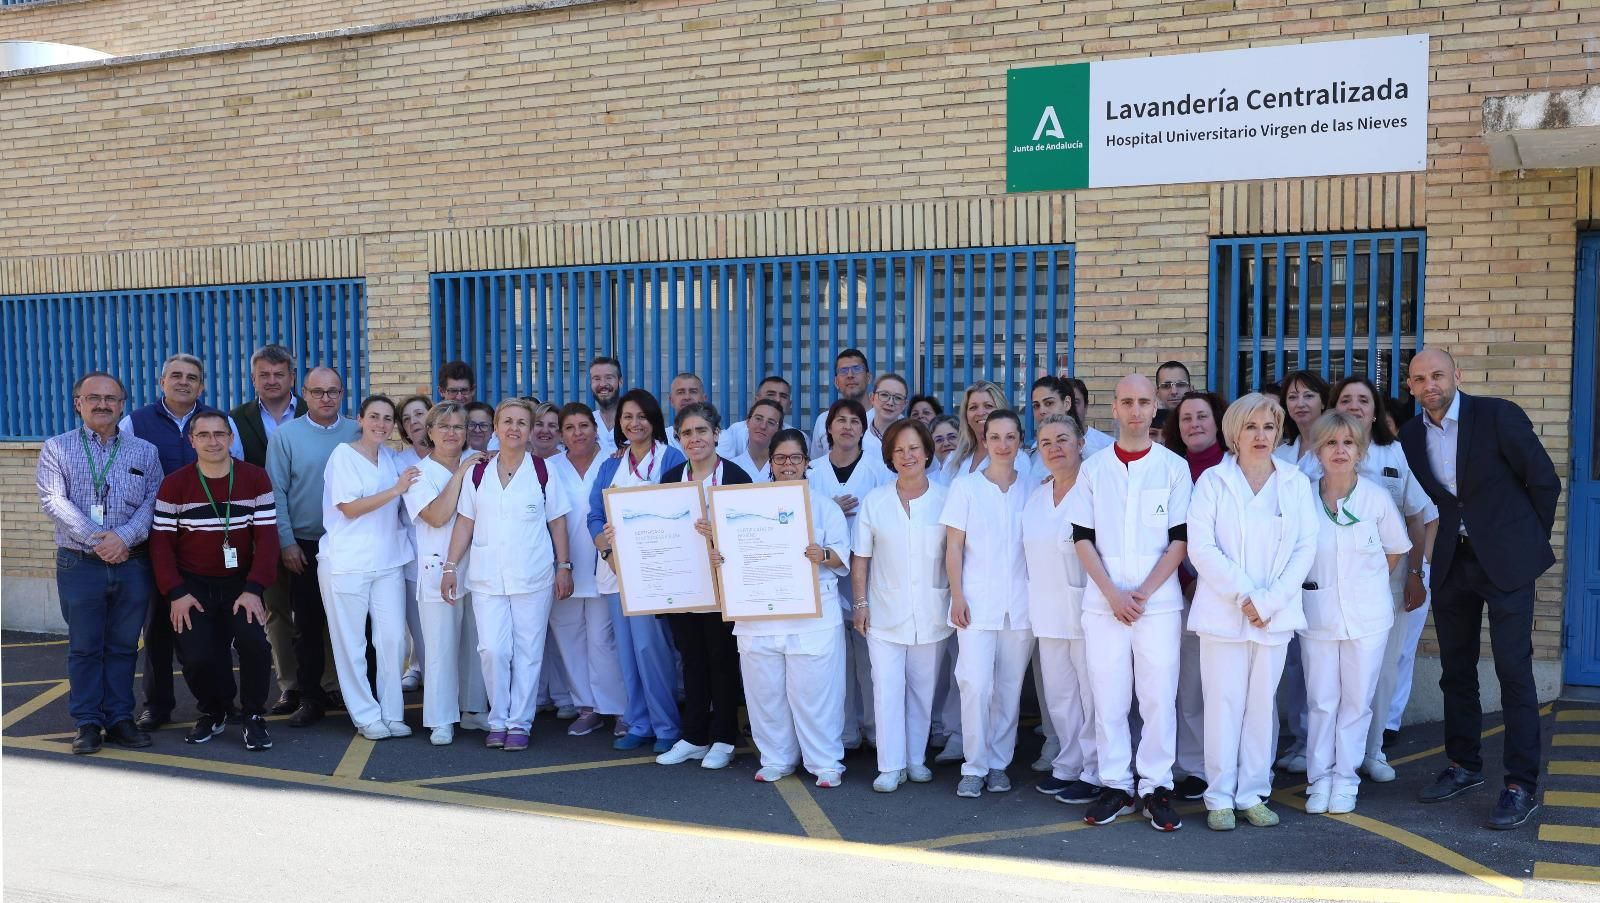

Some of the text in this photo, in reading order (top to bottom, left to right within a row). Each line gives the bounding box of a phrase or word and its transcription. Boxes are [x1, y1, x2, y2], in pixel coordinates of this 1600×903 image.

[1106, 77, 1409, 122] Lavandería Centralizada
[1012, 140, 1083, 153] Junta de Andalucía
[1106, 115, 1408, 148] Hospital Universitario Virgen de las Nieves
